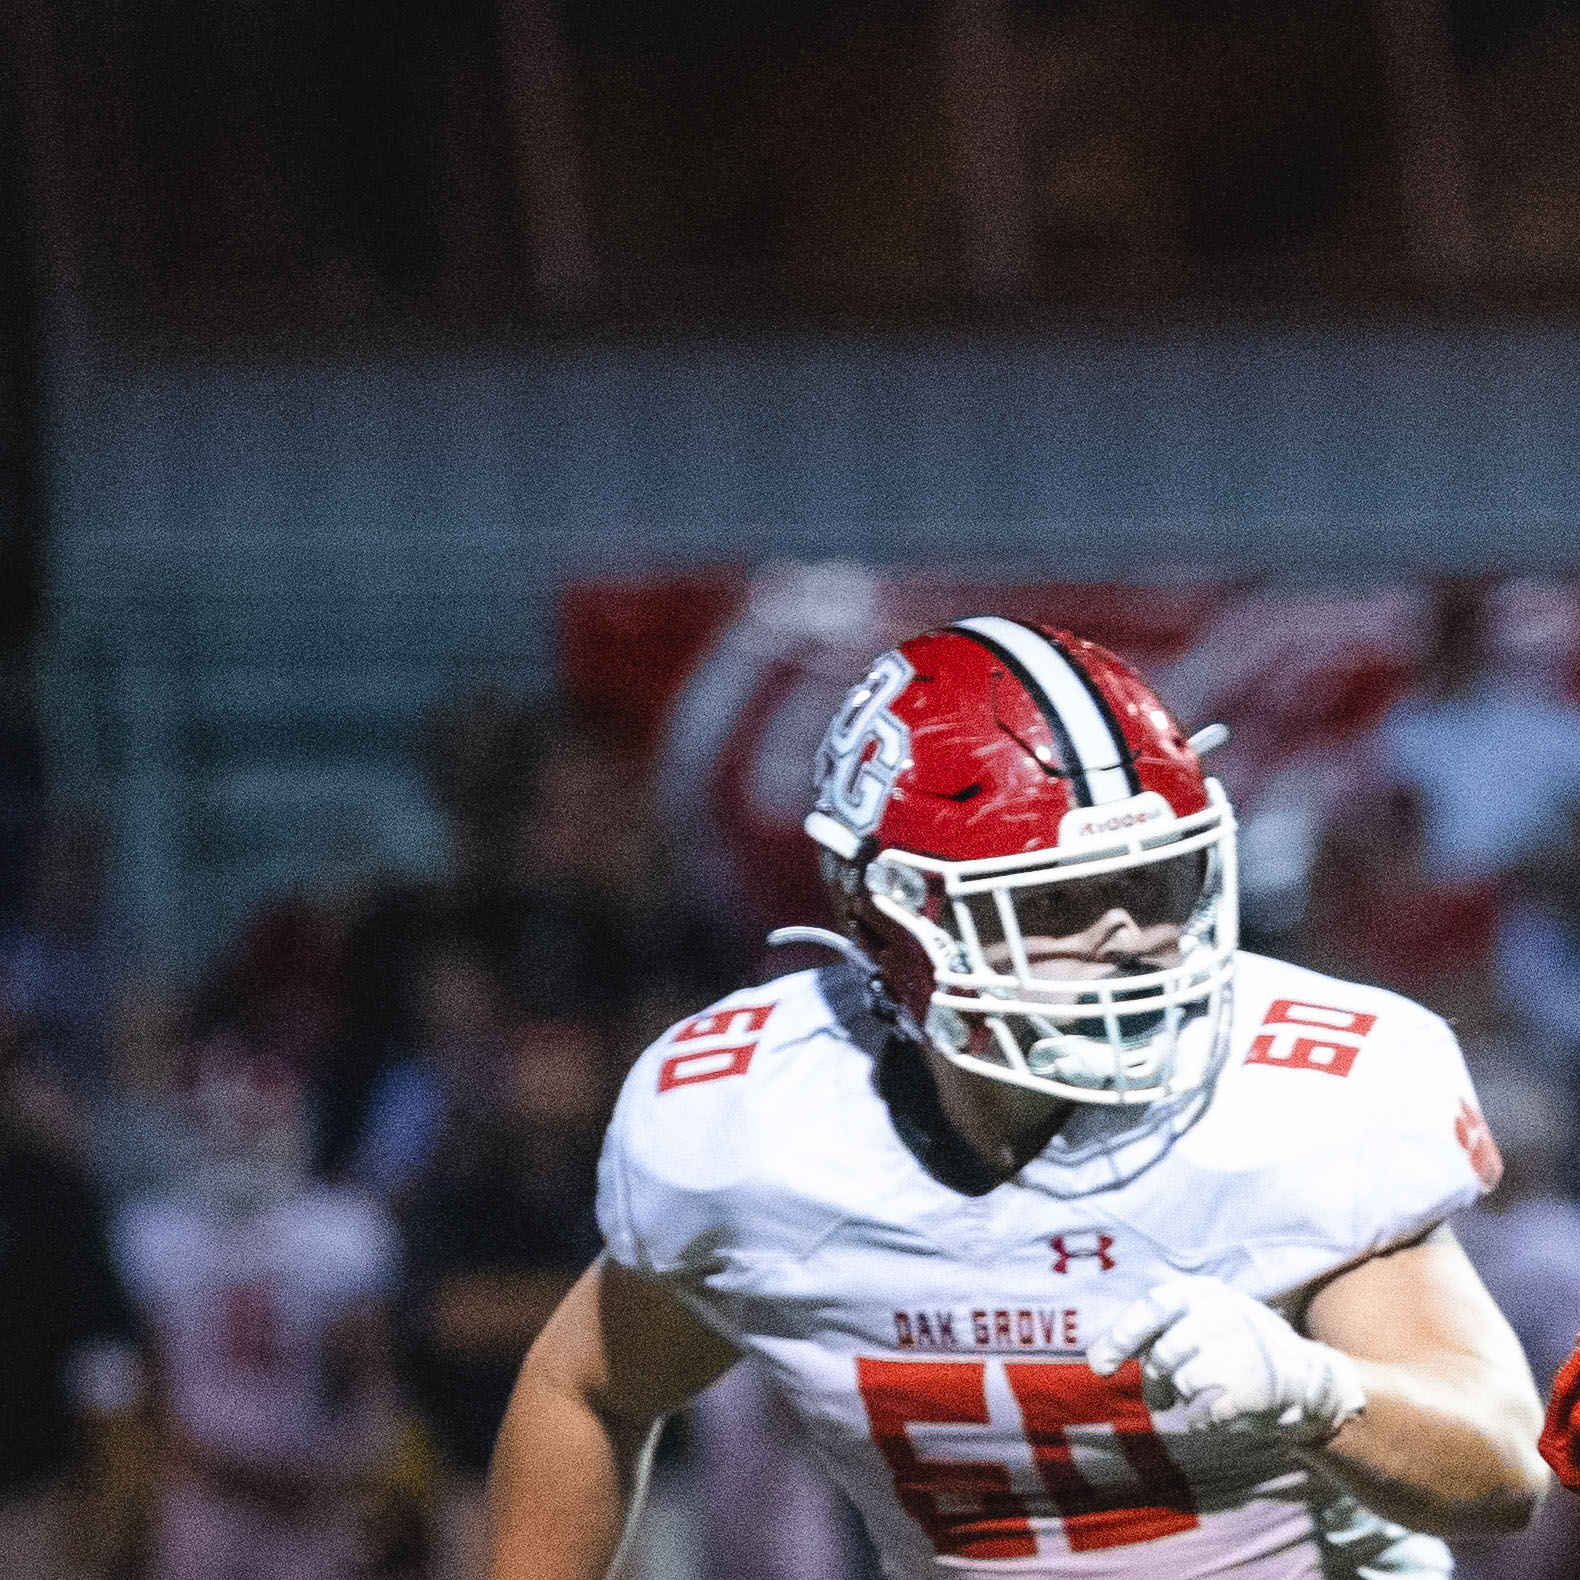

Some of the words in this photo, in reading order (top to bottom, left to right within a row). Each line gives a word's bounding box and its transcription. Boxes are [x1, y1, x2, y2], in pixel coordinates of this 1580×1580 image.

[1242, 998, 1379, 1080] 60
[894, 1308, 955, 1350] OAK
[970, 1308, 1080, 1347] GROVE
[855, 1355, 1200, 1560] 60
